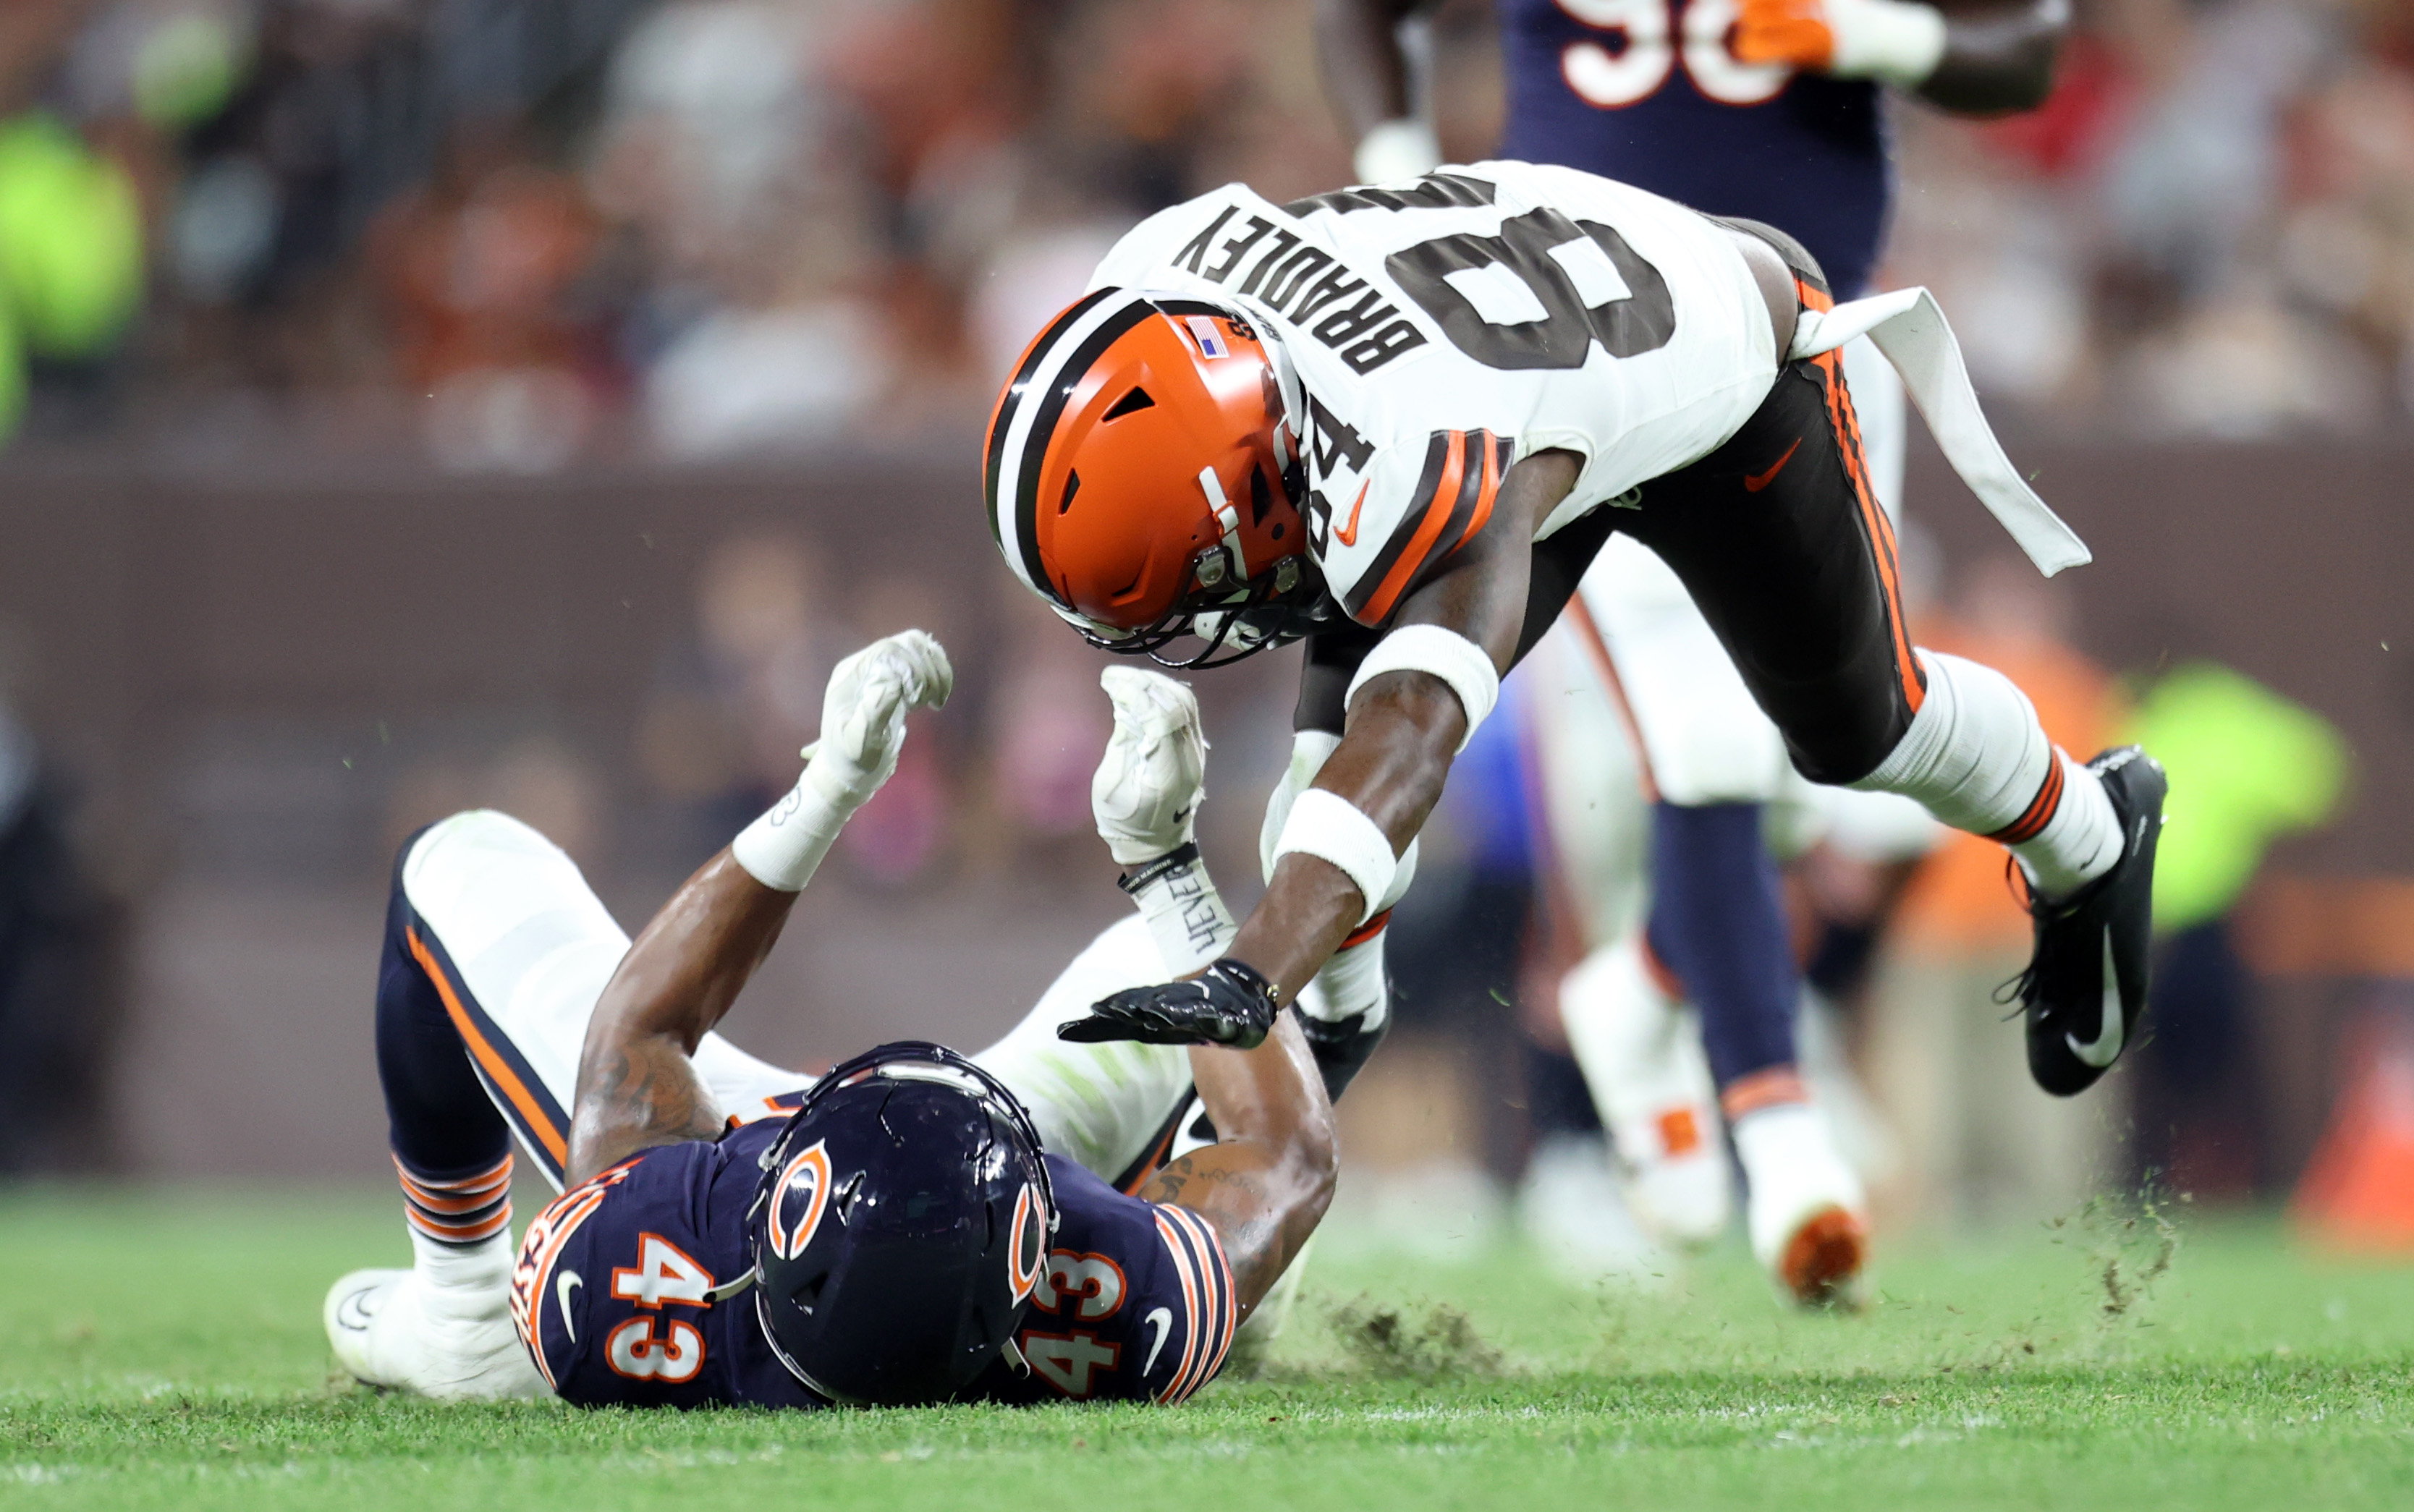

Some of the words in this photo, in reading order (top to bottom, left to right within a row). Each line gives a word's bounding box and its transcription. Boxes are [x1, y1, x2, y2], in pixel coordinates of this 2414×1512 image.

[1170, 203, 1429, 376] BRADLEY
[604, 1231, 716, 1384] 43
[1020, 1247, 1127, 1401] 43
